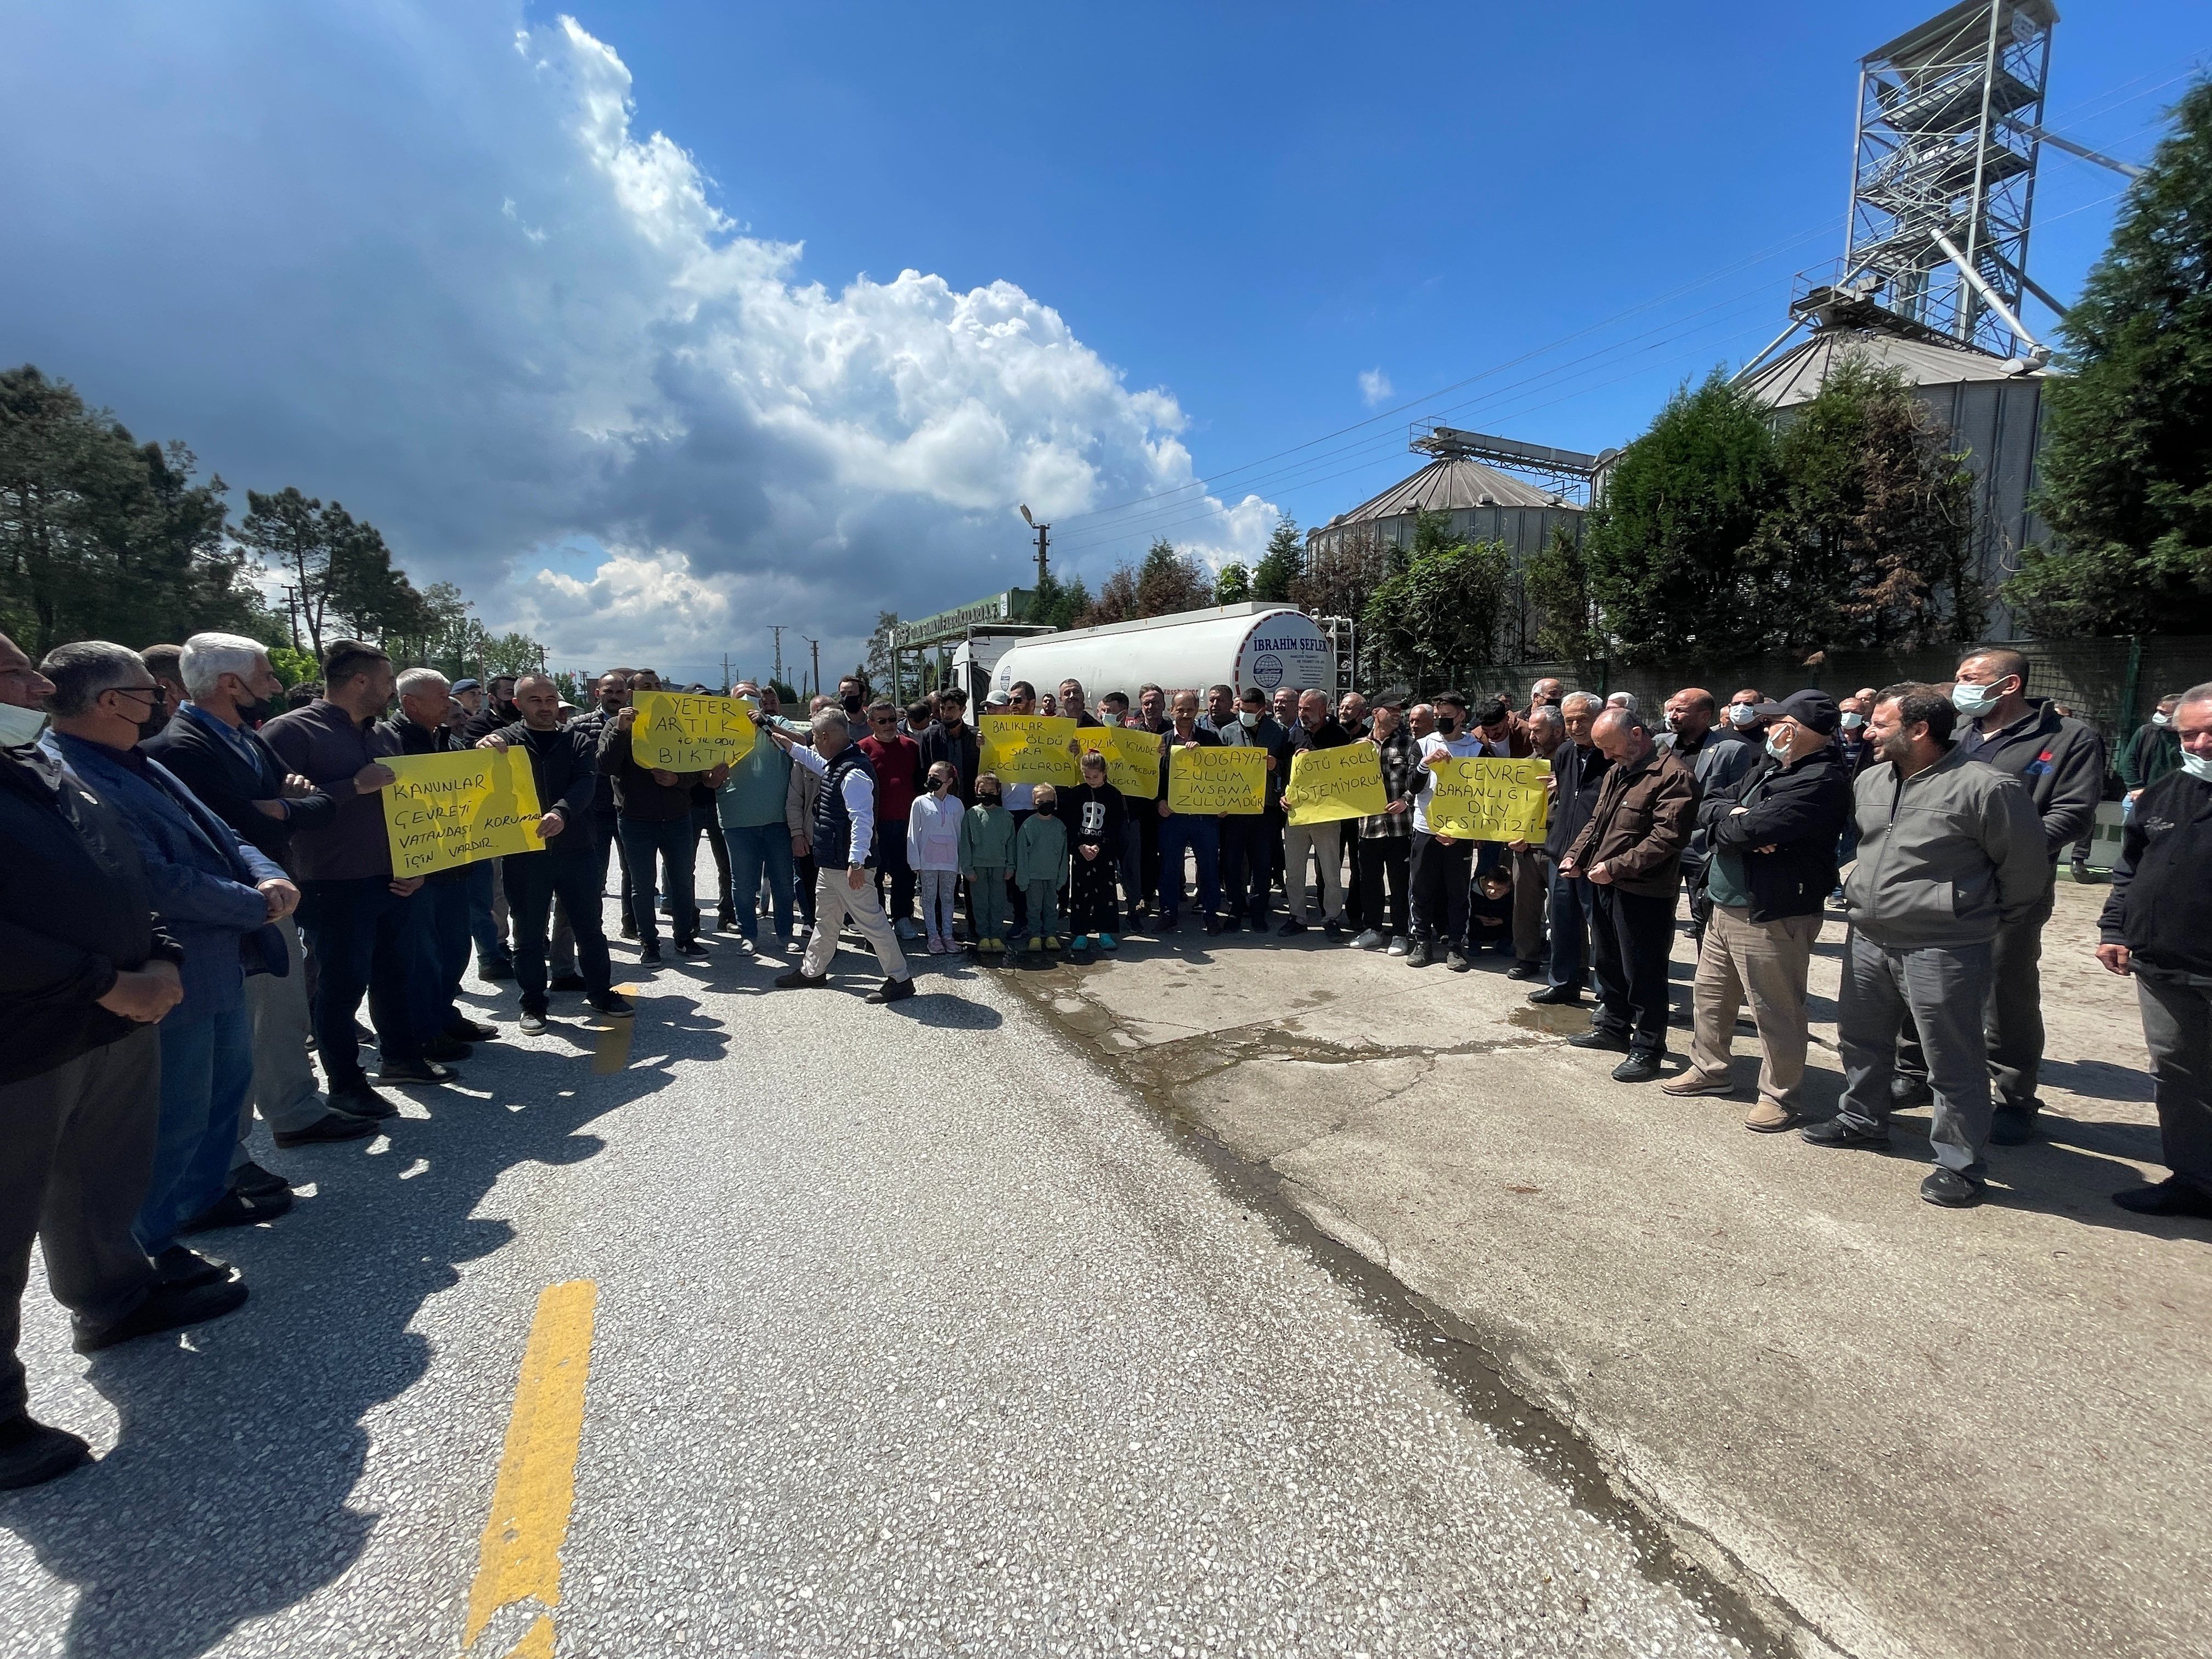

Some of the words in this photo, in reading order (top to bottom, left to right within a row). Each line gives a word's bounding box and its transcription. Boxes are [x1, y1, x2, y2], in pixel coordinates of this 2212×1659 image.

[1254, 635, 1297, 652] İBRAHİM
[1300, 637, 1328, 654] ŞEFLEK
[672, 697, 736, 716] YETER
[655, 717, 740, 732] ARTIK
[993, 720, 1047, 733] BALIKLAR
[1026, 734, 1063, 746] ÖLDÜ
[1125, 738, 1158, 756] İÇİNDE
[659, 748, 741, 764] BIKTIK
[1009, 747, 1042, 756] SIRA
[1193, 751, 1262, 766] DOĞAYA
[1128, 764, 1158, 778] MECBUR
[1295, 756, 1330, 775] KÖTÜ
[1340, 752, 1375, 769] KOKU
[1173, 769, 1244, 782] ZULÜM
[1459, 762, 1531, 784] ÇEVRE
[393, 774, 487, 801] KANUNLAR
[1190, 783, 1251, 794] İNSANA
[1296, 772, 1384, 803] İSTEMİYORUM
[1435, 782, 1528, 801] BAKANLIĞI
[1176, 795, 1265, 808] ZULÜMDÜR
[1468, 800, 1509, 817] DUY
[394, 800, 472, 829] ÇEVREYİ
[399, 825, 472, 849] VATANDAŞI
[404, 850, 433, 868] İÇİN
